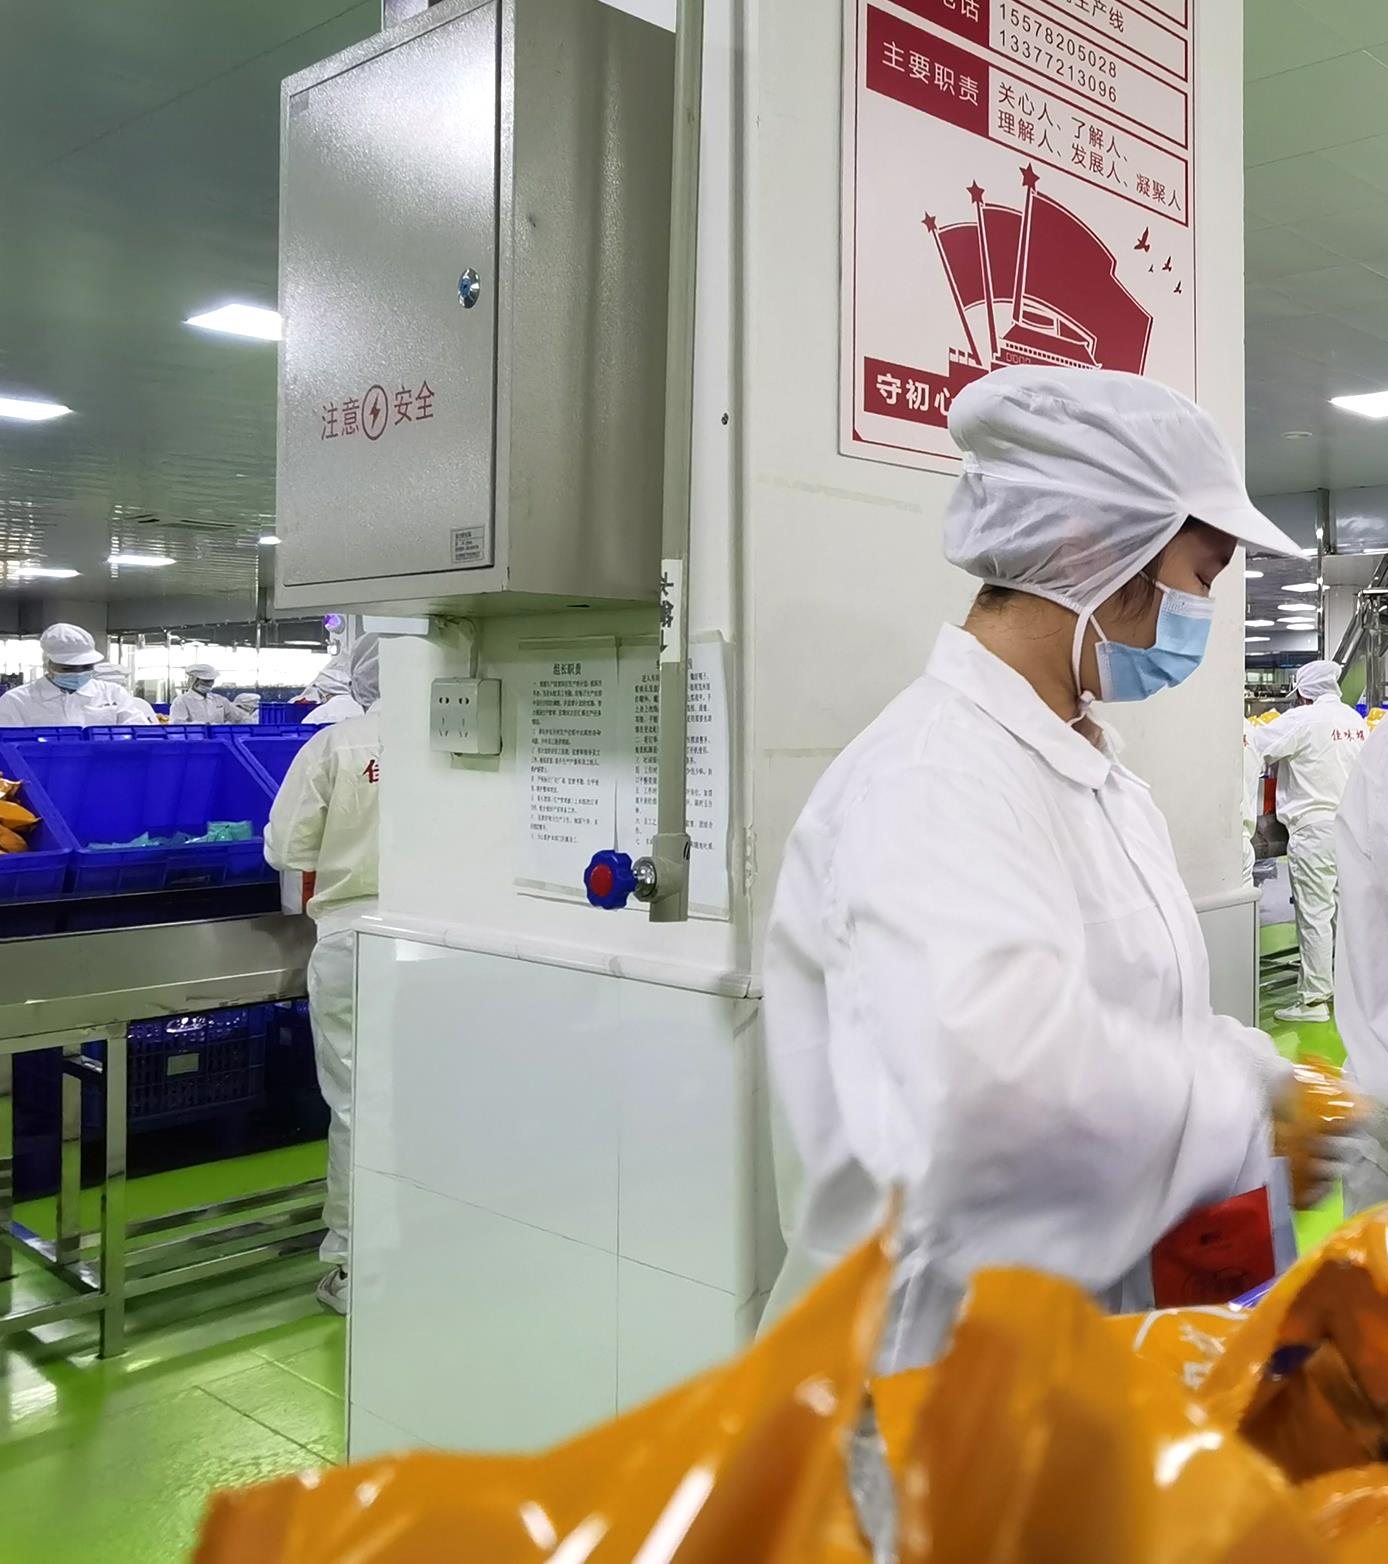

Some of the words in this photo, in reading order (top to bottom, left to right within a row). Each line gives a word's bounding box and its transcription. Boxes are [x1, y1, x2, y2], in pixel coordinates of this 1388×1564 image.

[882, 41, 979, 106] 主要职责
[1000, 3, 1118, 78] 15578205028
[1000, 31, 1118, 103] 13377213096
[998, 82, 1128, 162] 关心人、了解人、
[998, 109, 1181, 211] 理解人、发展人、凝聚人
[321, 397, 360, 440] 注意
[393, 380, 435, 426] 安全
[876, 373, 950, 416] 守初心
